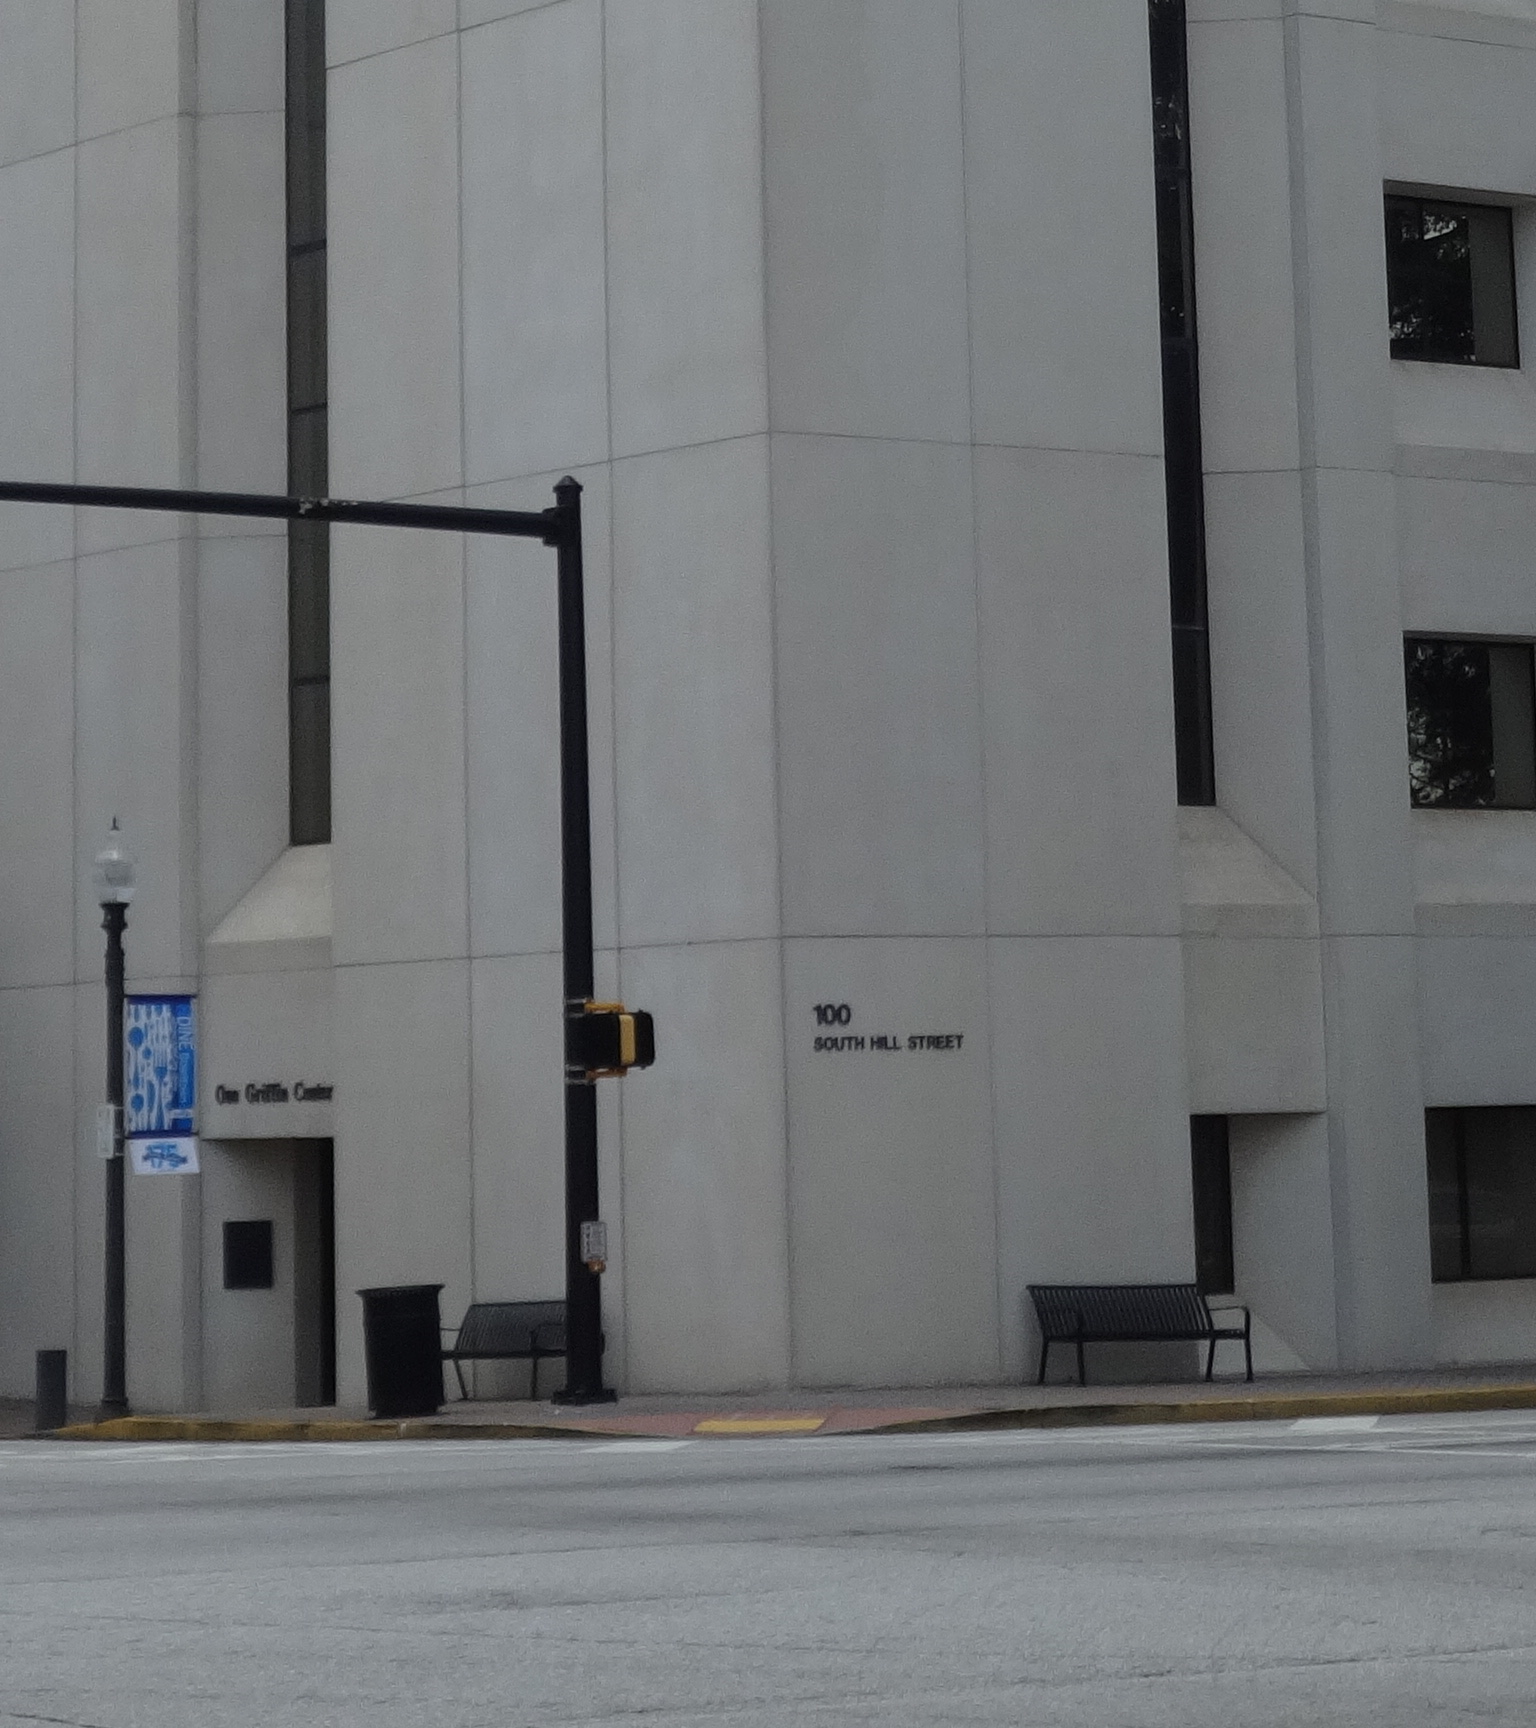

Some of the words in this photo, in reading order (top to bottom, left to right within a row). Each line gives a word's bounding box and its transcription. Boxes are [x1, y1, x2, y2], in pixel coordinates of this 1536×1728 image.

[813, 1003, 851, 1026] 100
[177, 1016, 194, 1051] DINE
[814, 1036, 865, 1051] SOUTH
[870, 1036, 902, 1051] HILL
[907, 1034, 964, 1050] STREET
[216, 1084, 239, 1105] One
[245, 1083, 289, 1104] Griffin
[293, 1082, 334, 1103] Center
